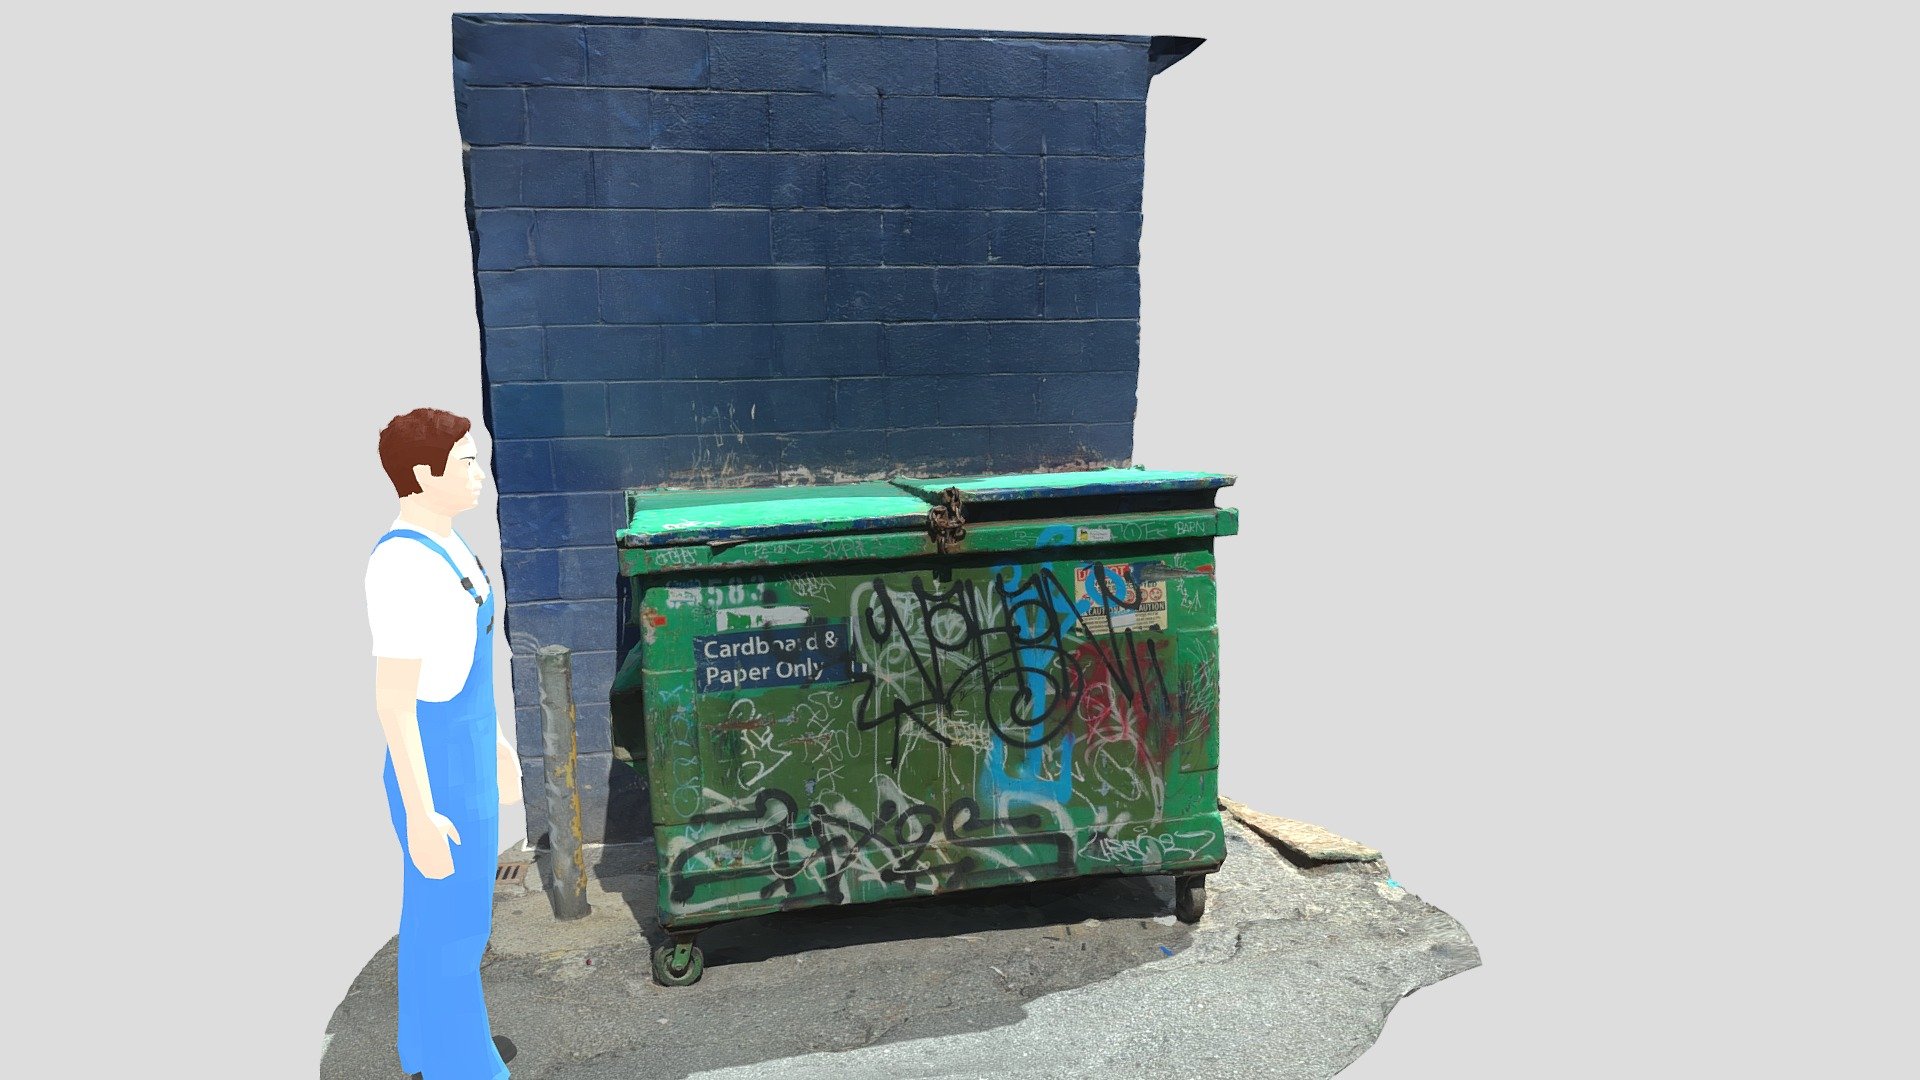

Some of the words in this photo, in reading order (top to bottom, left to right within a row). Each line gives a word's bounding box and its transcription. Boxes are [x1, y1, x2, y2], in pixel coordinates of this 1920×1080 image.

[1137, 601, 1165, 612] AUTION
[703, 632, 820, 660] Cardbad
[824, 630, 839, 649] &
[706, 664, 771, 687] Paper
[775, 657, 825, 682] Only
